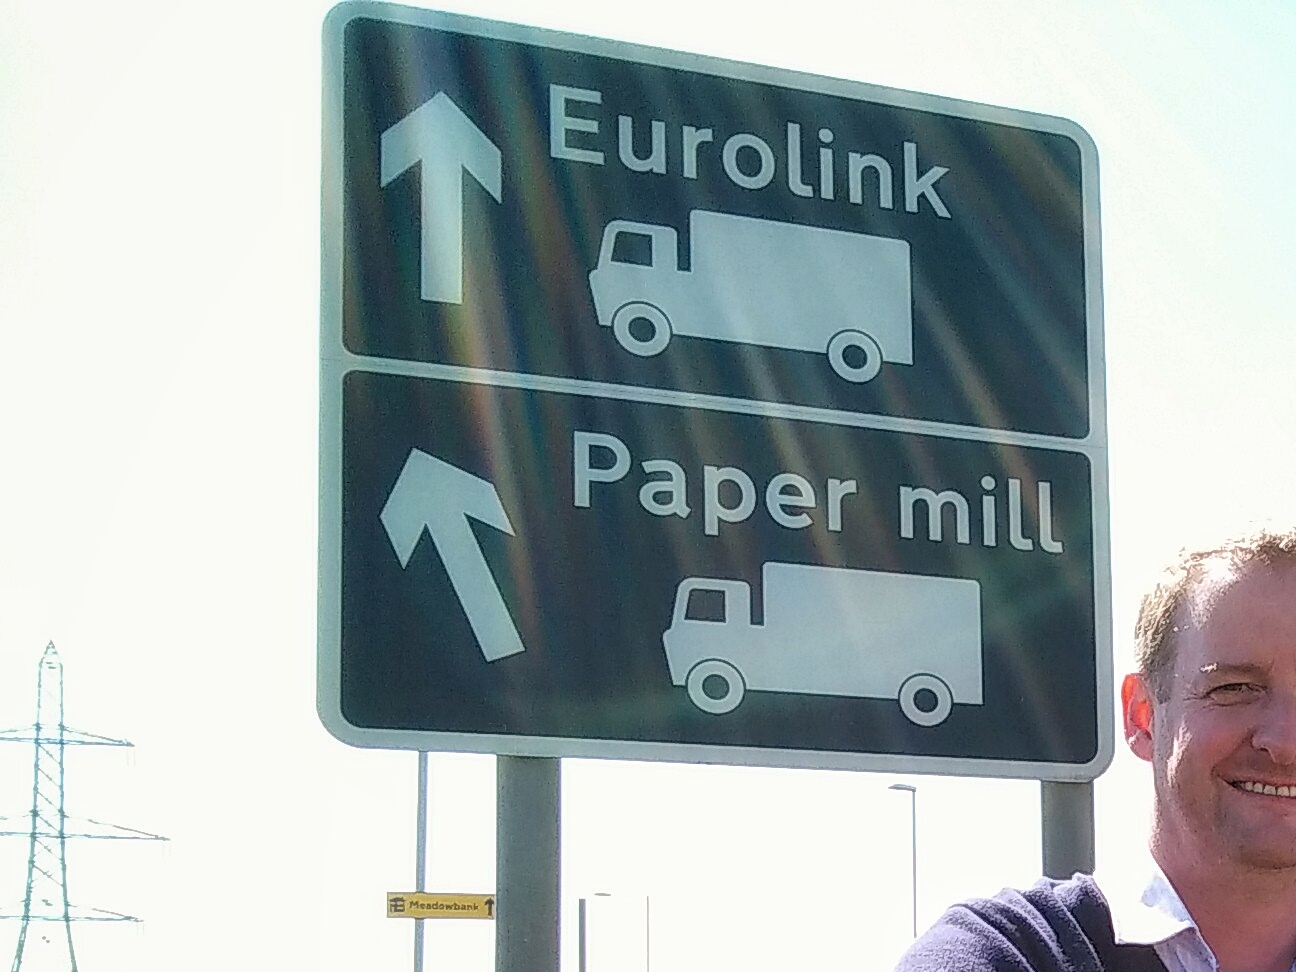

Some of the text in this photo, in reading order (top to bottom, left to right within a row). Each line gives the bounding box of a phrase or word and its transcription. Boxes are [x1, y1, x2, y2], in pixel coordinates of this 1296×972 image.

[548, 83, 952, 219] Eurolink
[573, 430, 1065, 554] Paper mill
[409, 900, 479, 911] Meadowbank
